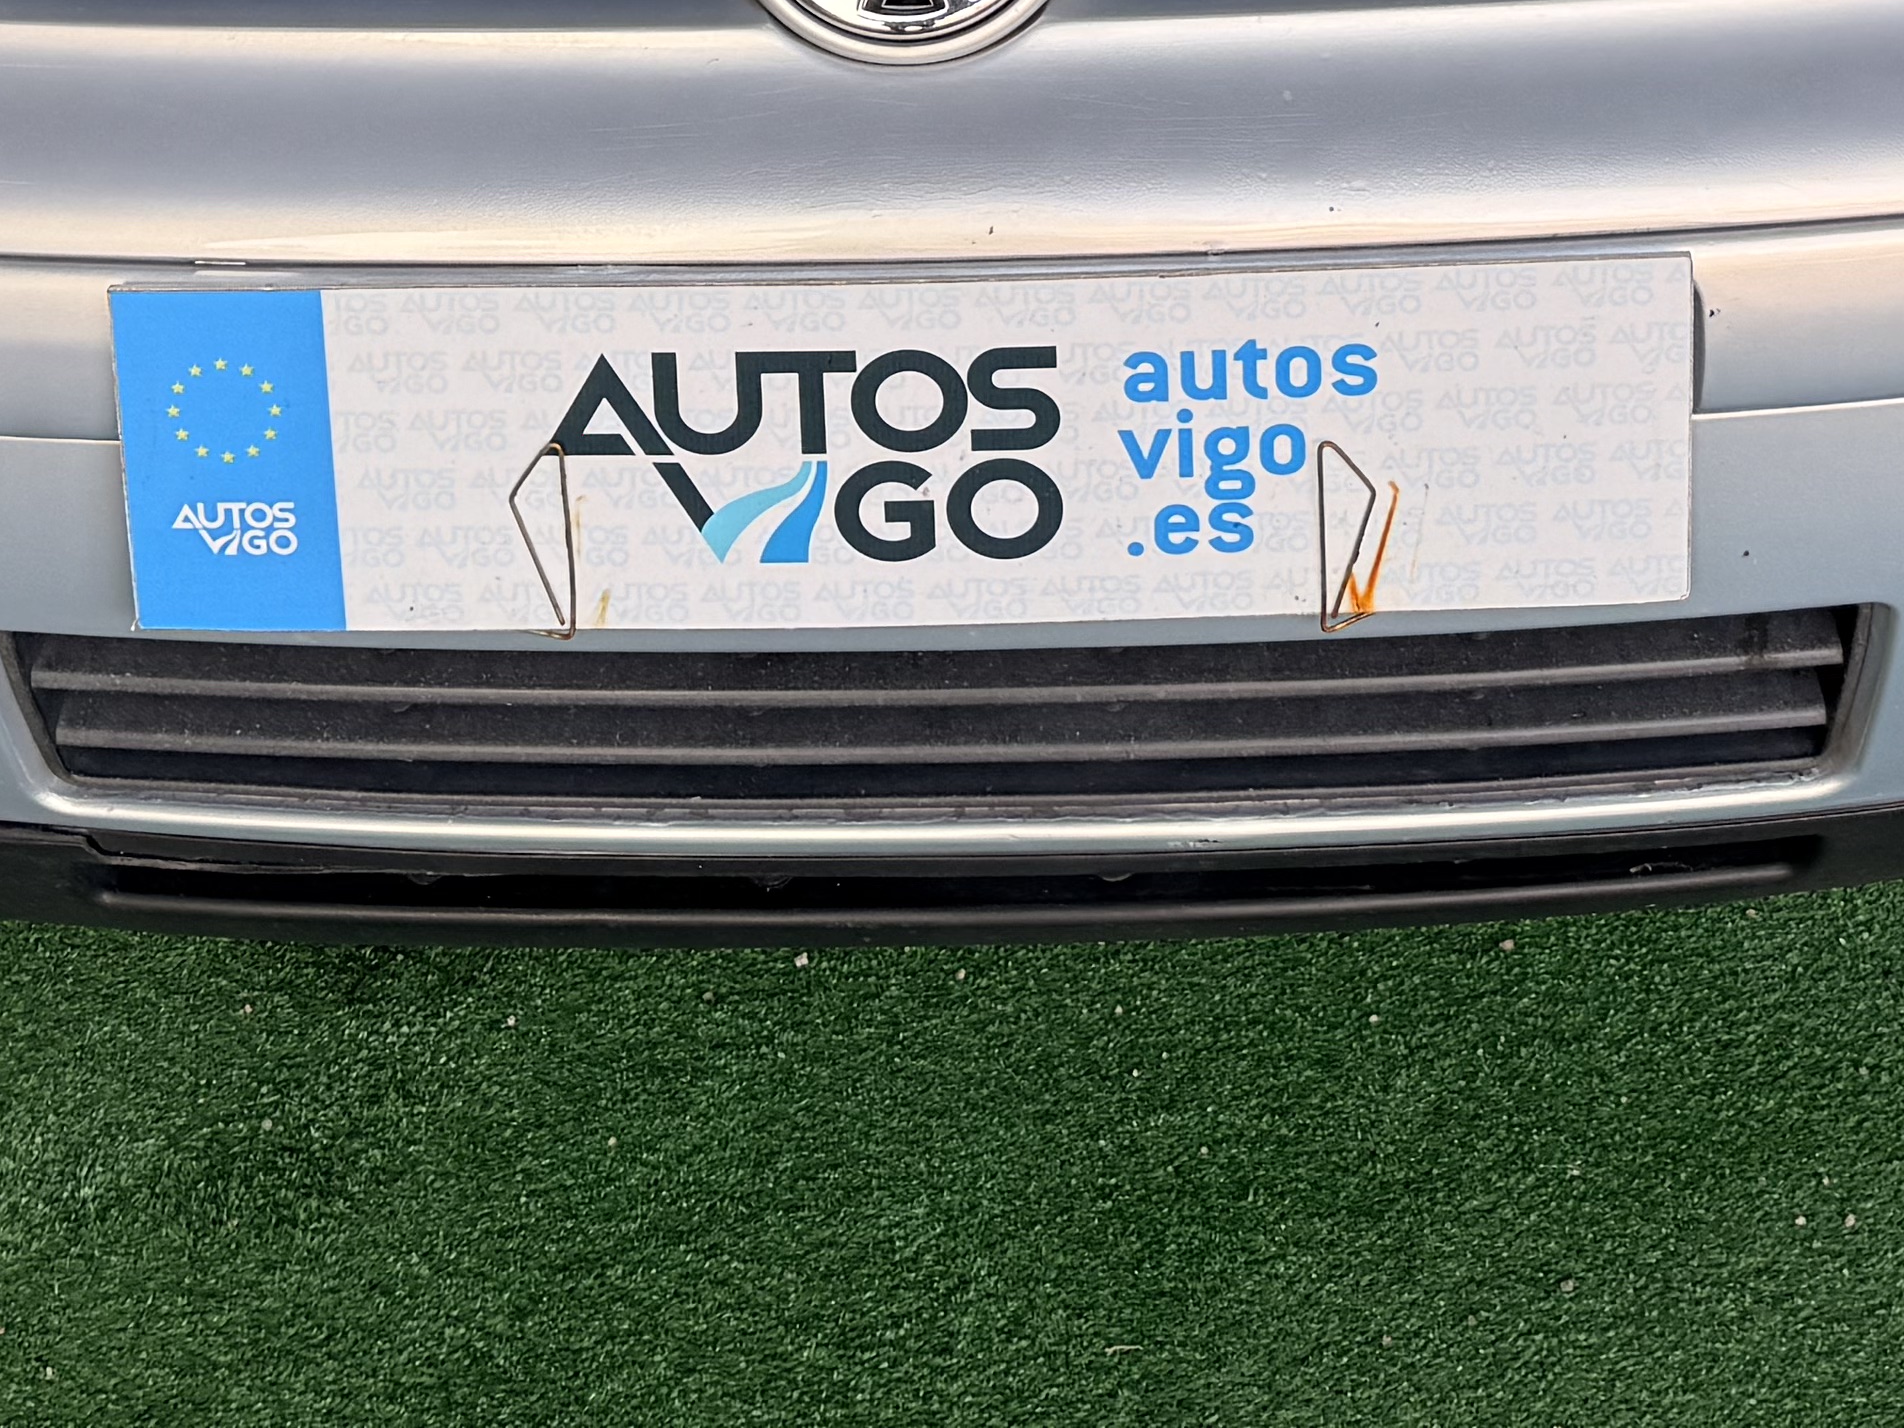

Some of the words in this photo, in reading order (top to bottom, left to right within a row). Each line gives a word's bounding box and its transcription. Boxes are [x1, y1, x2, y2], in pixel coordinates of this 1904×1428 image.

[550, 344, 1062, 456] AUTOS
[1122, 339, 1379, 403] autos
[1118, 408, 1307, 501] vigo
[172, 501, 296, 530] AUTOS
[200, 528, 299, 557] VIGO
[652, 457, 1065, 564] VIGO
[1127, 500, 1256, 558] .es
